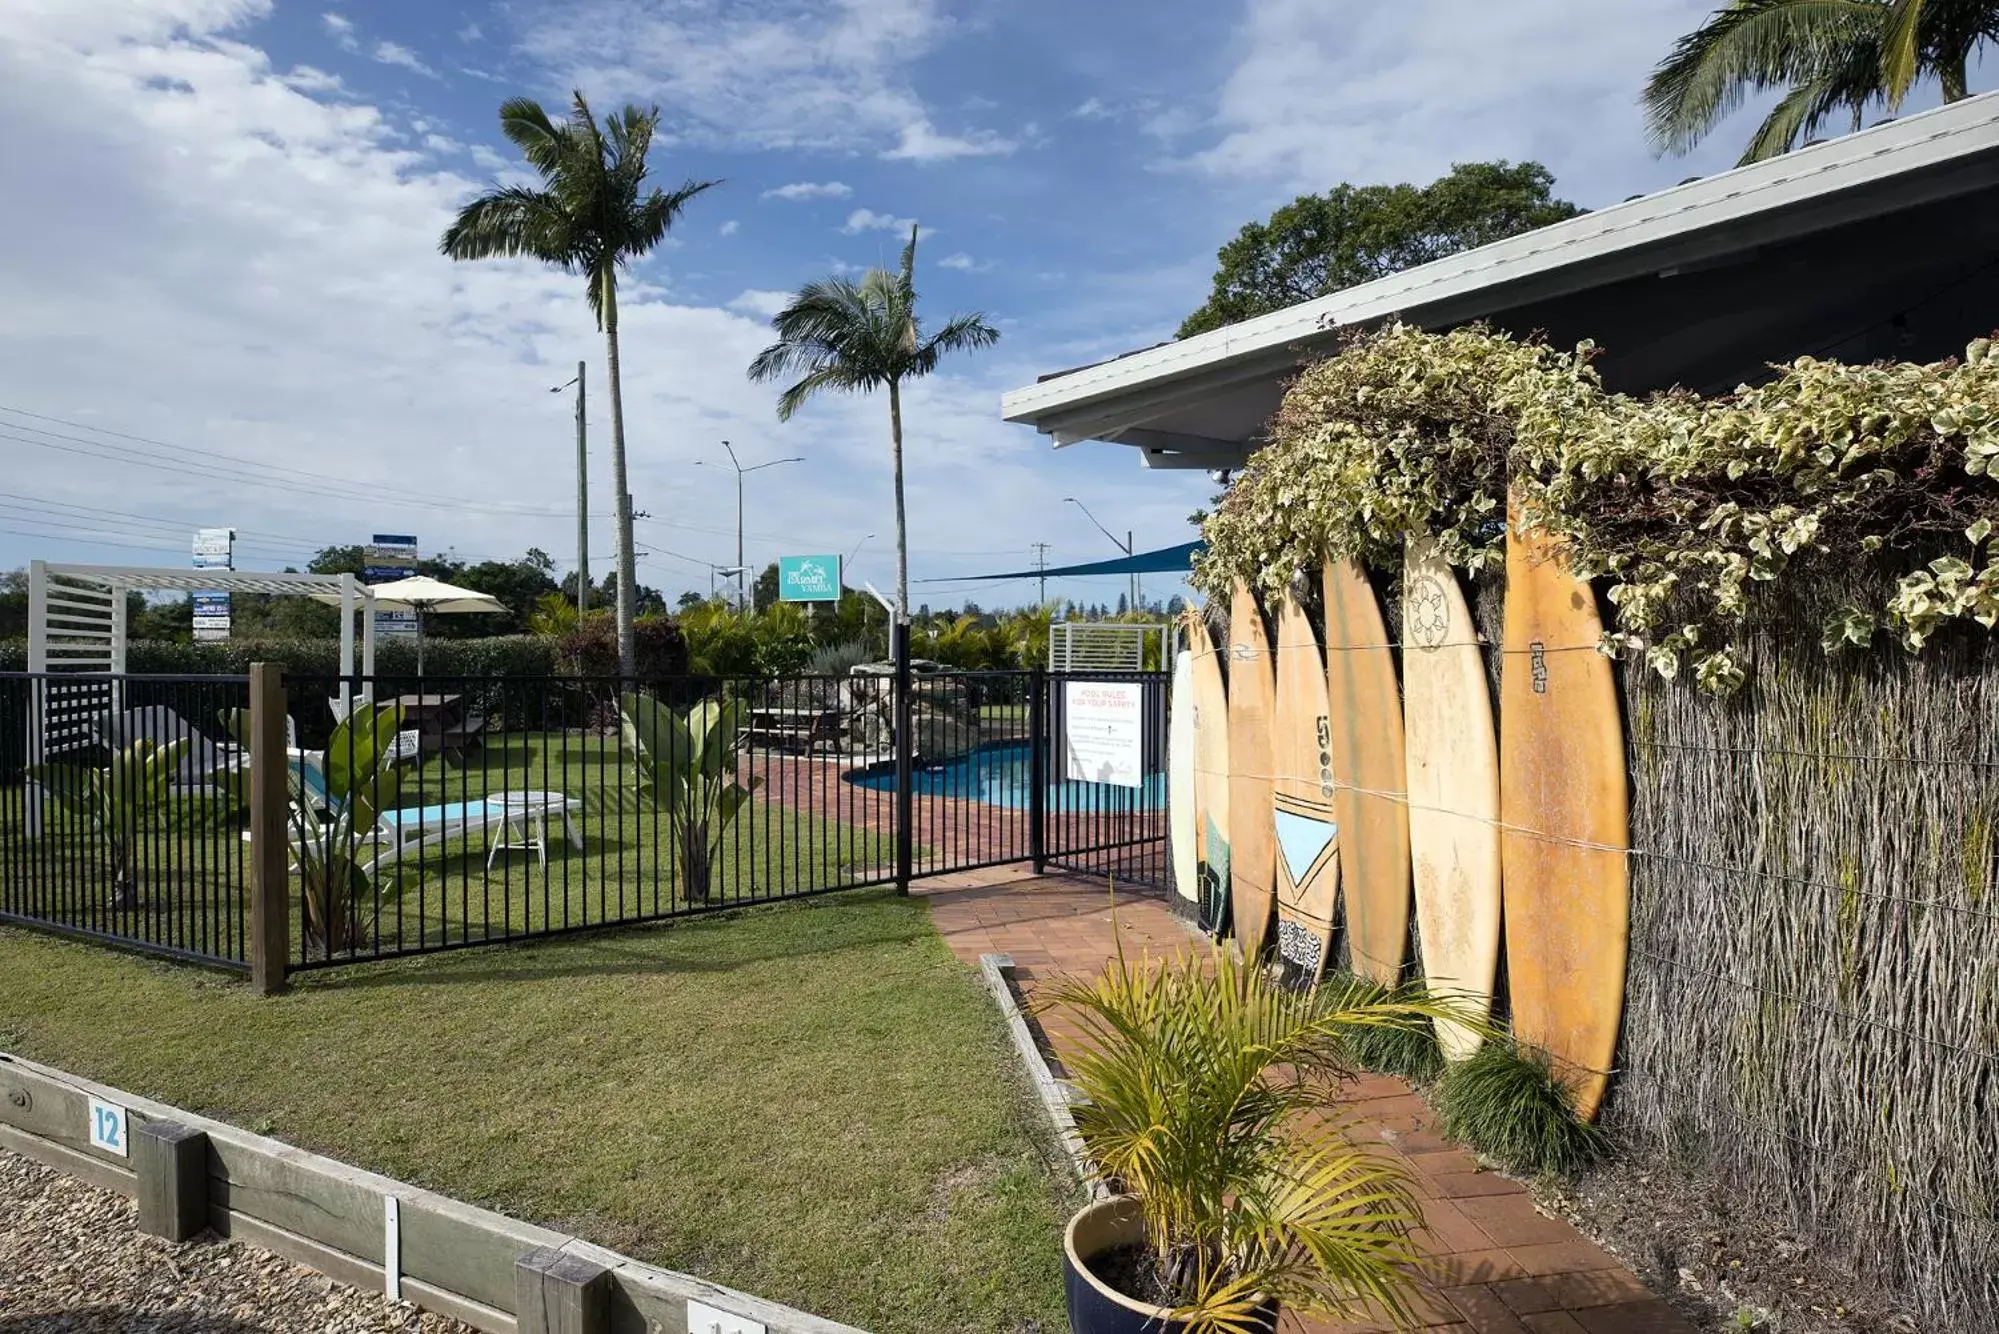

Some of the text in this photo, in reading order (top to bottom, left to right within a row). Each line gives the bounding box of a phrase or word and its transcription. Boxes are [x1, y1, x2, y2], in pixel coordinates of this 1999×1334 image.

[1081, 690, 1126, 699] POOL RULES
[1072, 698, 1135, 708] FOR YOUR SAFETY
[95, 1106, 119, 1147] 12
